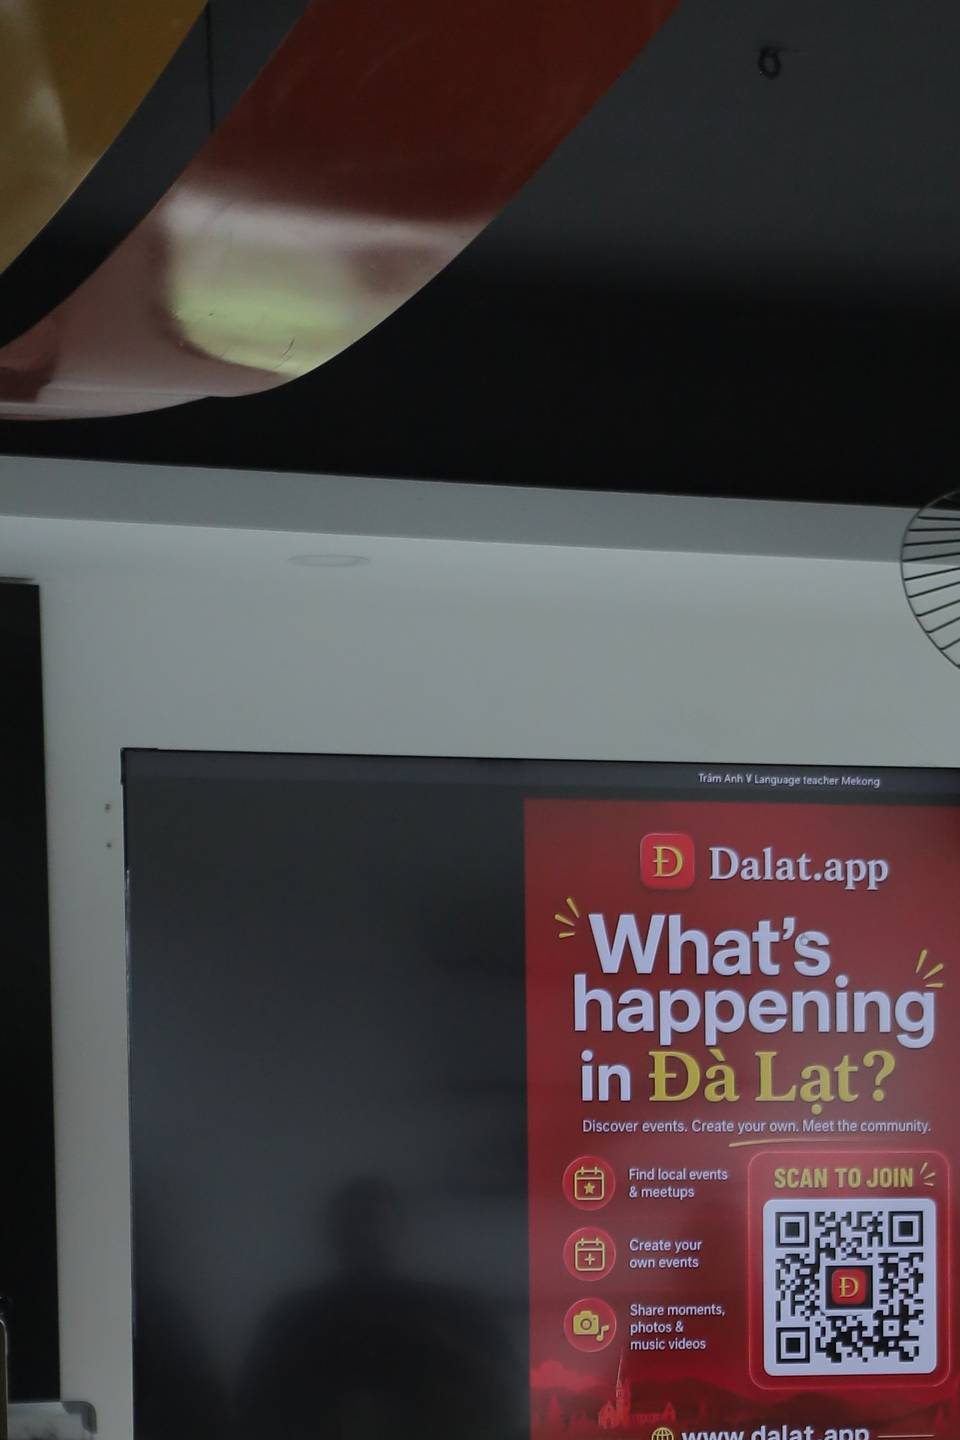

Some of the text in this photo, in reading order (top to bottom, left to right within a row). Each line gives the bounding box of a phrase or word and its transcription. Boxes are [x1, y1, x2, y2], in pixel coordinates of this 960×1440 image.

[724, 774, 743, 783] Anh
[754, 775, 800, 787] Language
[803, 776, 840, 785] teacher
[841, 776, 880, 788] Mekong
[709, 846, 889, 891] Dalat.app
[588, 913, 831, 976] What’s
[574, 974, 936, 1049] happening
[581, 1048, 895, 1115] in Đà Lạt?
[582, 1119, 931, 1135] Discover events. Create your own. Meet the community.
[629, 1168, 728, 1181] Find local events
[774, 1167, 913, 1189] SCAN TO JOIN
[629, 1186, 694, 1200] & meetups
[629, 1239, 702, 1254] Create your
[630, 1257, 699, 1269] own events
[630, 1304, 725, 1317] Share moments,
[630, 1320, 684, 1335] photos &
[630, 1338, 706, 1351] music videos
